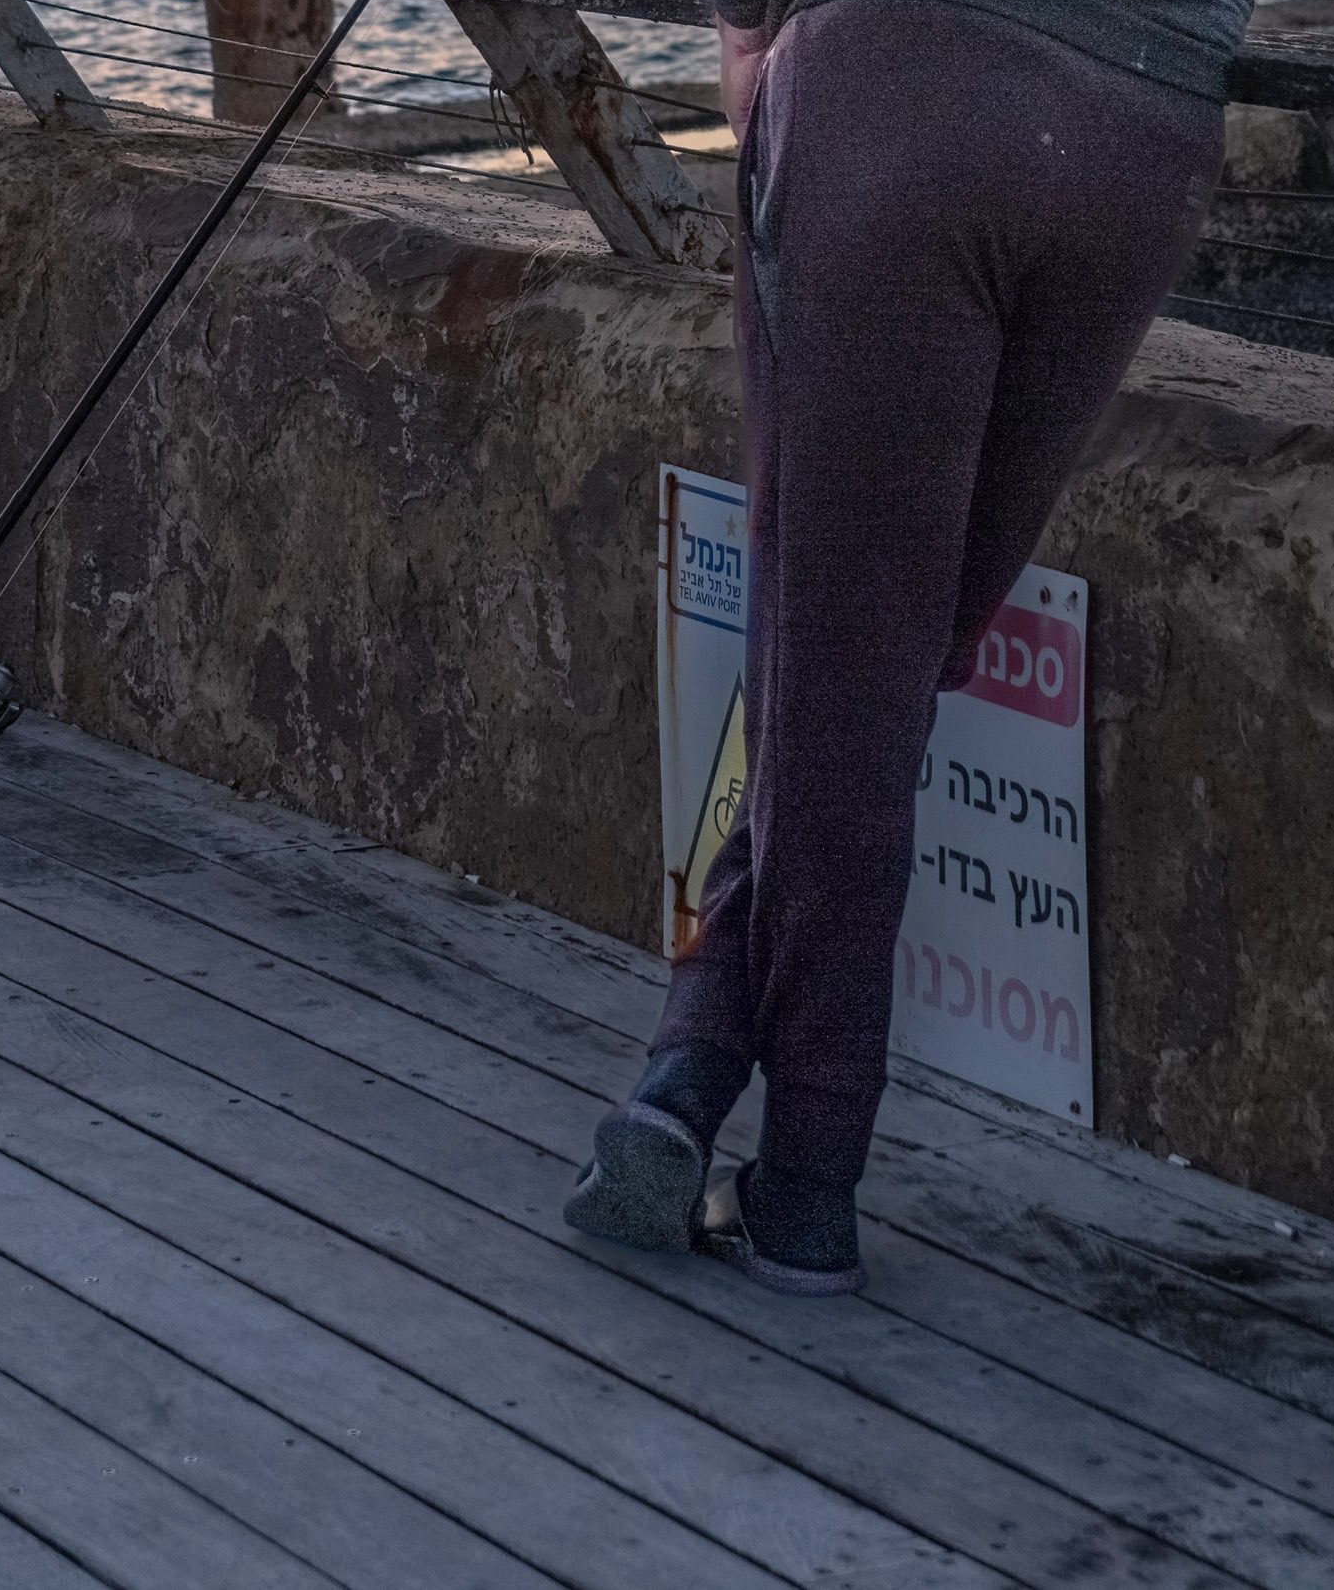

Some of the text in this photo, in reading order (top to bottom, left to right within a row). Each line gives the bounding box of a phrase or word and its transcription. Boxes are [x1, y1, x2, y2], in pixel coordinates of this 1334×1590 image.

[680, 521, 741, 580] הנמל
[679, 585, 741, 616] TEL AVIV PORT
[680, 569, 741, 598] של תל אביב
[948, 759, 1078, 843] הרכיבה
[1008, 869, 1080, 936] העץ
